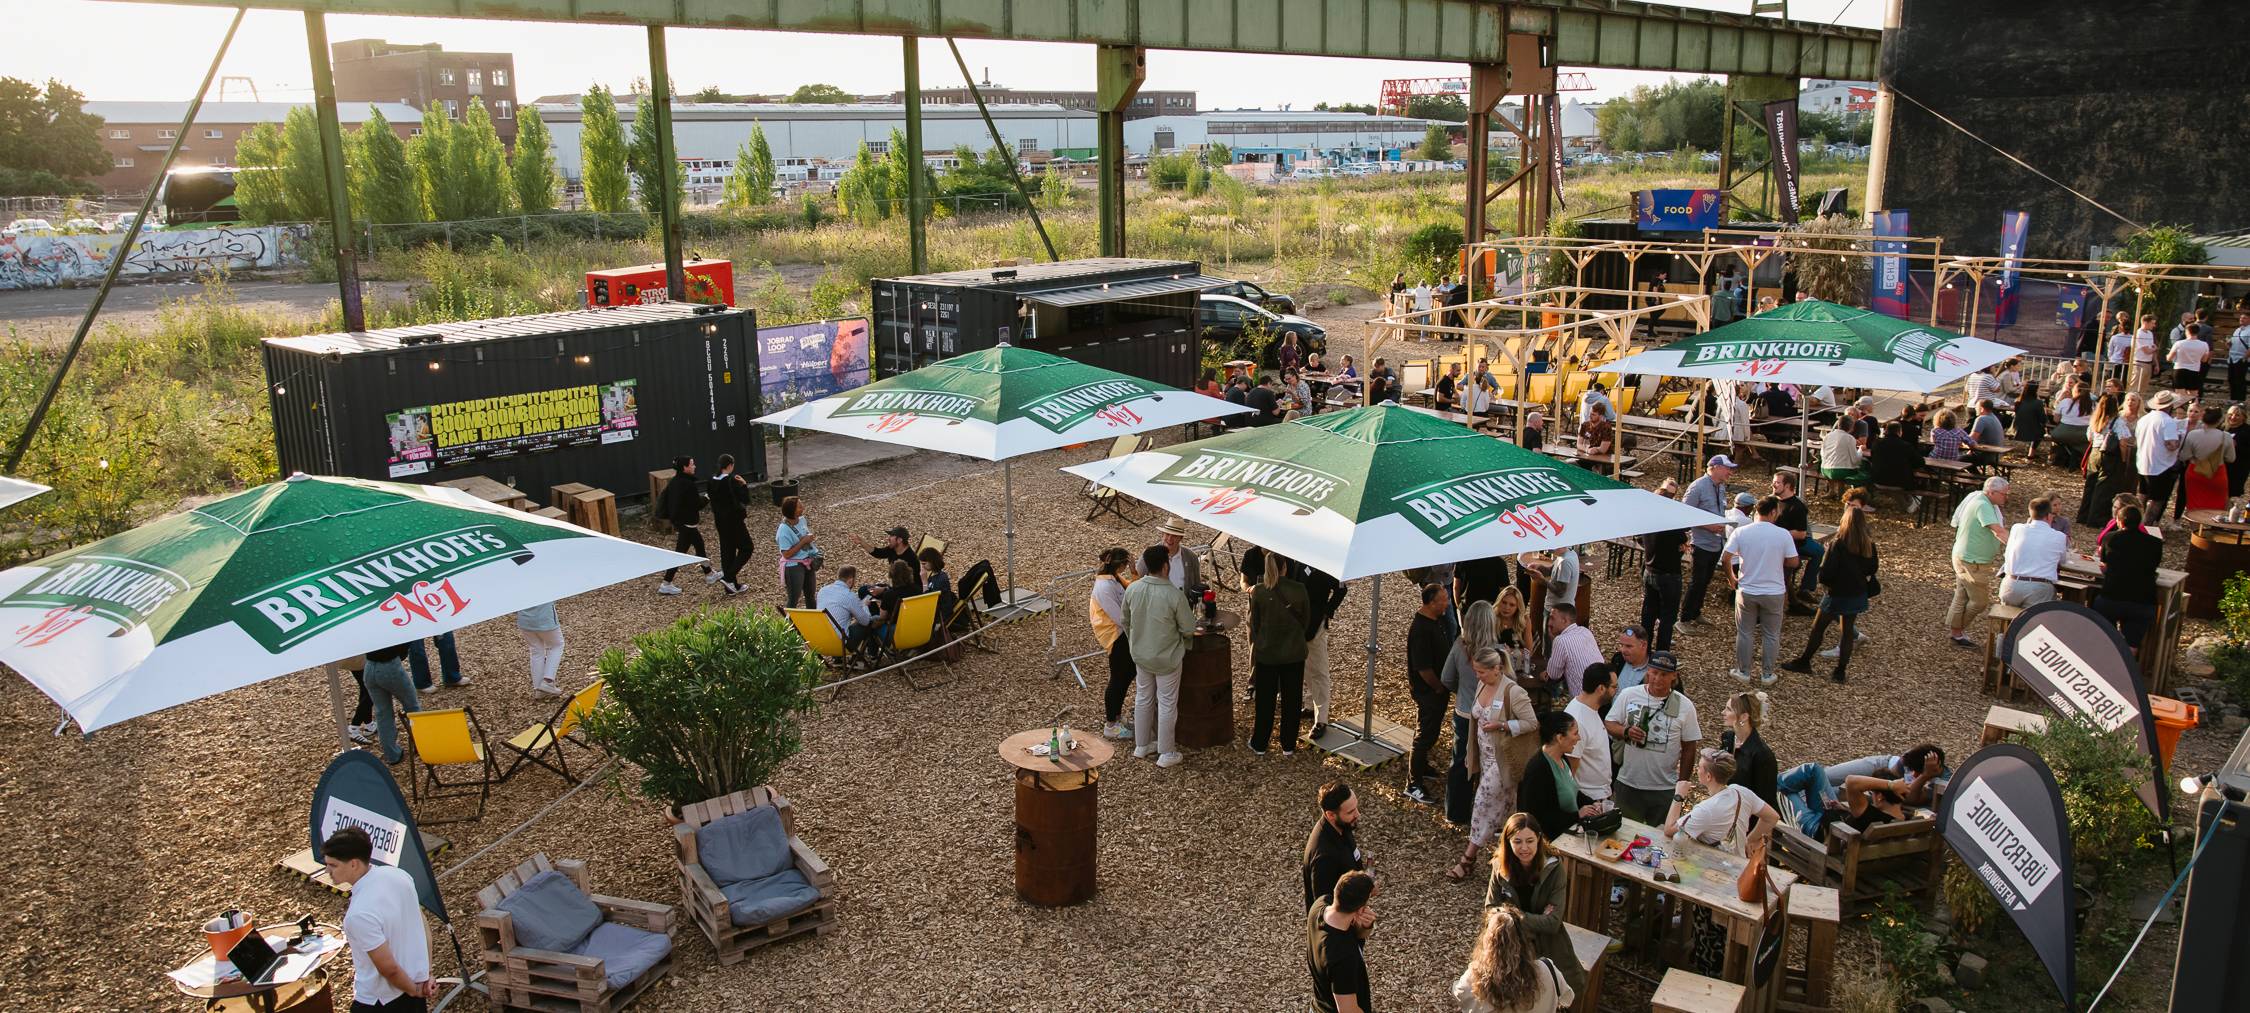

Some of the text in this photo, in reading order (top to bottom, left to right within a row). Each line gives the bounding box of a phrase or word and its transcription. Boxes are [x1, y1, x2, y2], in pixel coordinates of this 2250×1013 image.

[1664, 206, 1693, 214] FOOD
[766, 335, 795, 345] JOBRAD
[768, 343, 786, 352] LOOP
[437, 429, 478, 448] BANG
[481, 423, 521, 441] BANG
[522, 417, 560, 435] BANG
[563, 411, 600, 430] BANG
